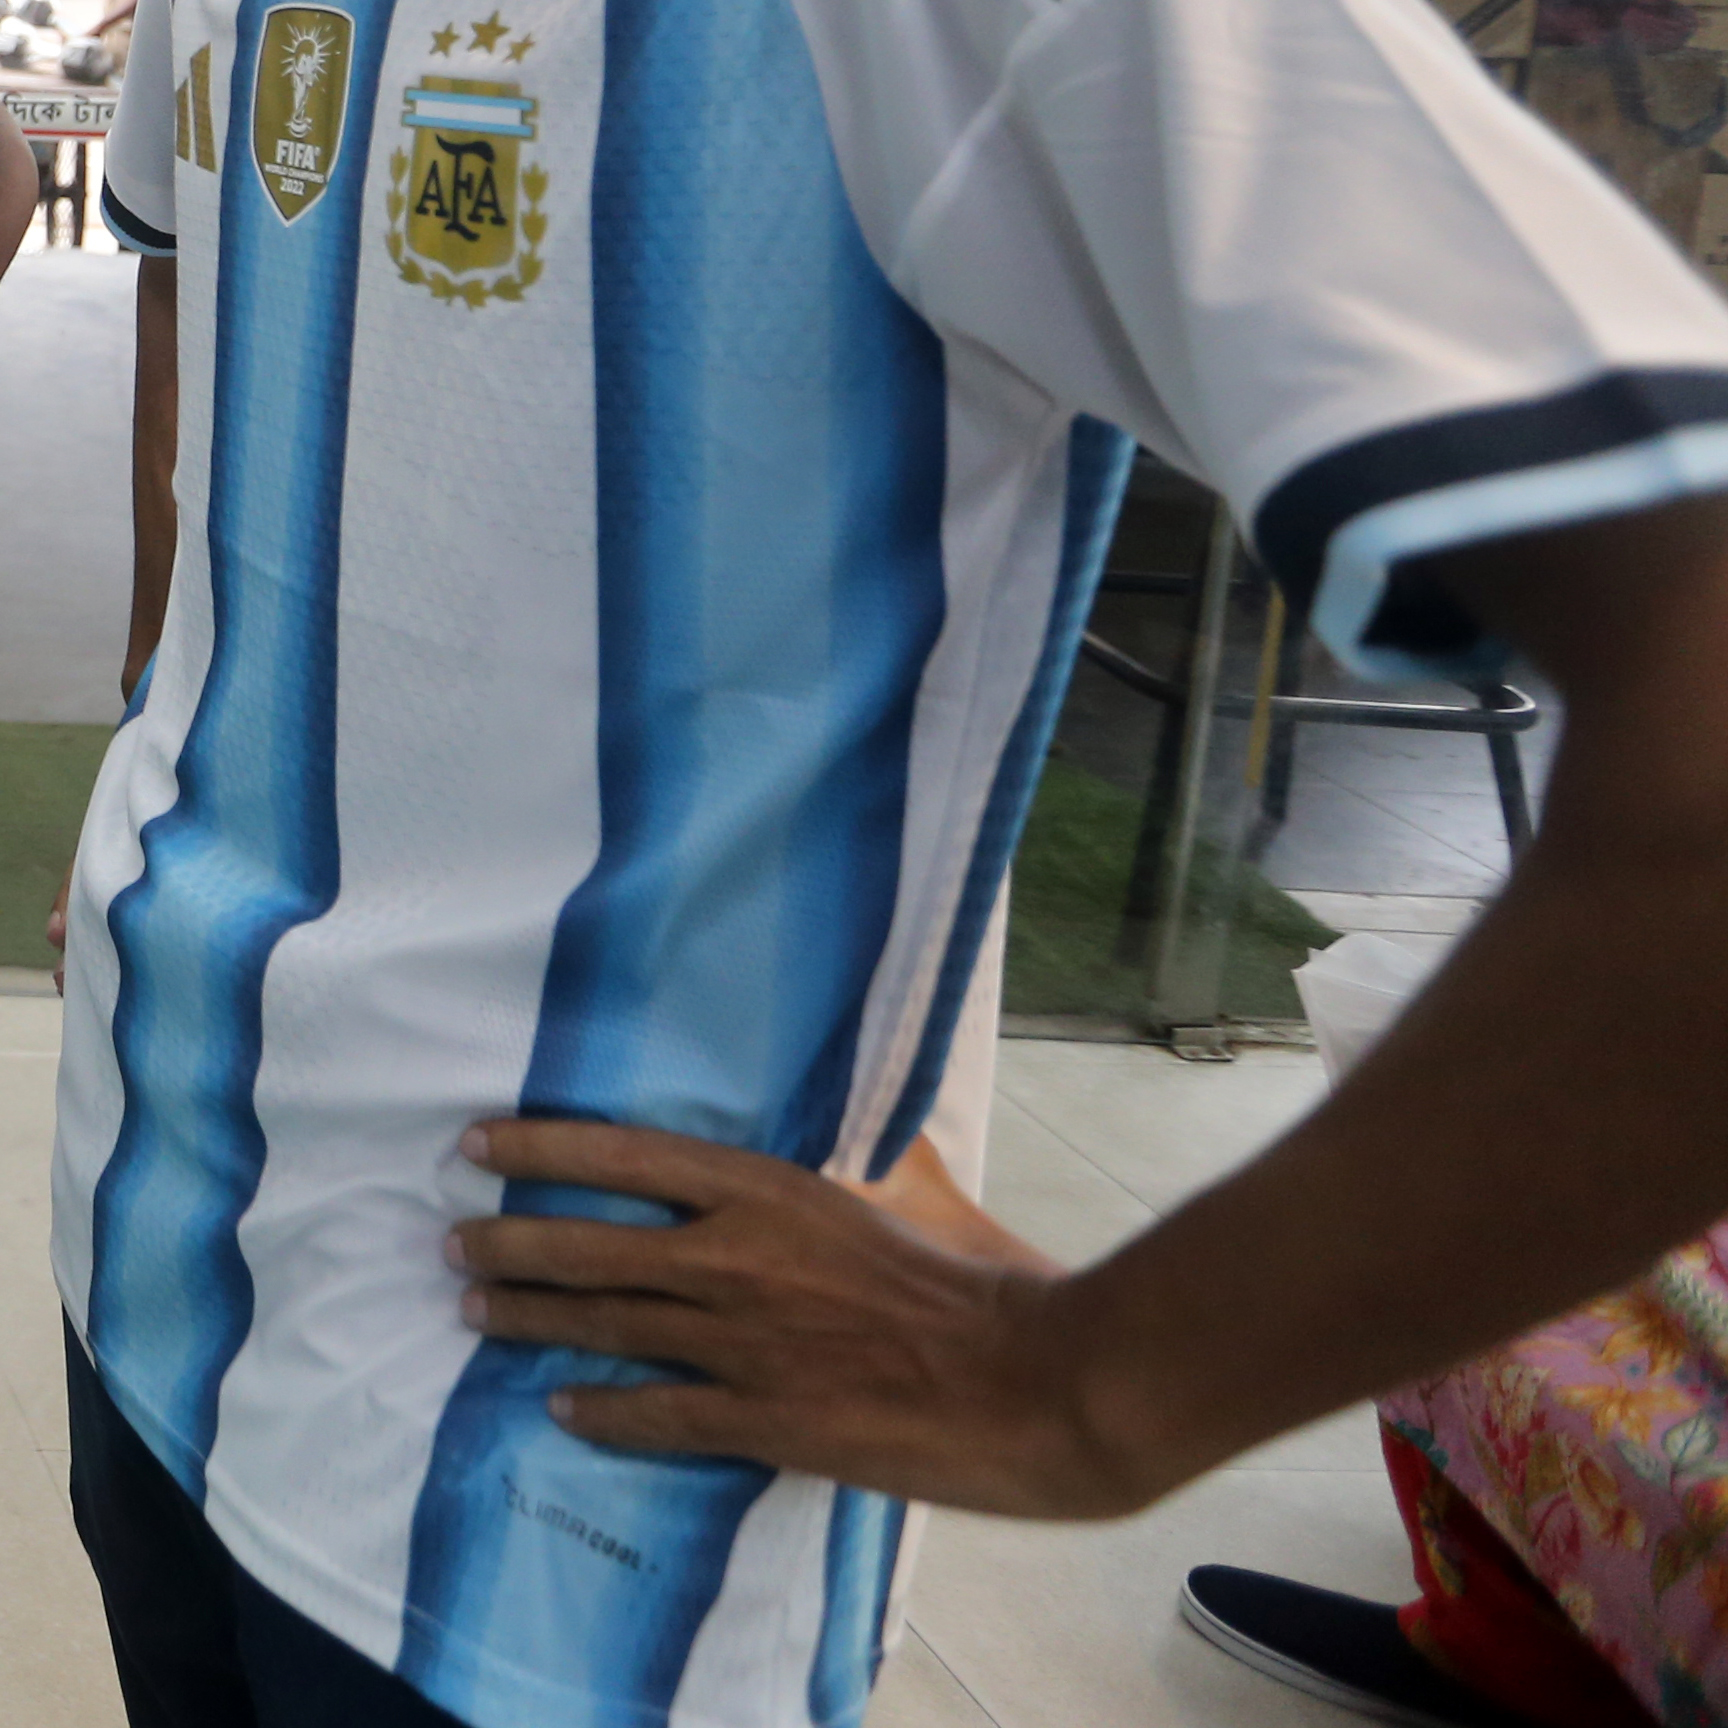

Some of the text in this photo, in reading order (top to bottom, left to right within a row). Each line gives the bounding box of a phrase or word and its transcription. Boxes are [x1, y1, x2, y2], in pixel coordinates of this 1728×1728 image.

[275, 138, 320, 171] FIFA
[279, 177, 305, 196] 2022
[415, 133, 508, 241] AFA
